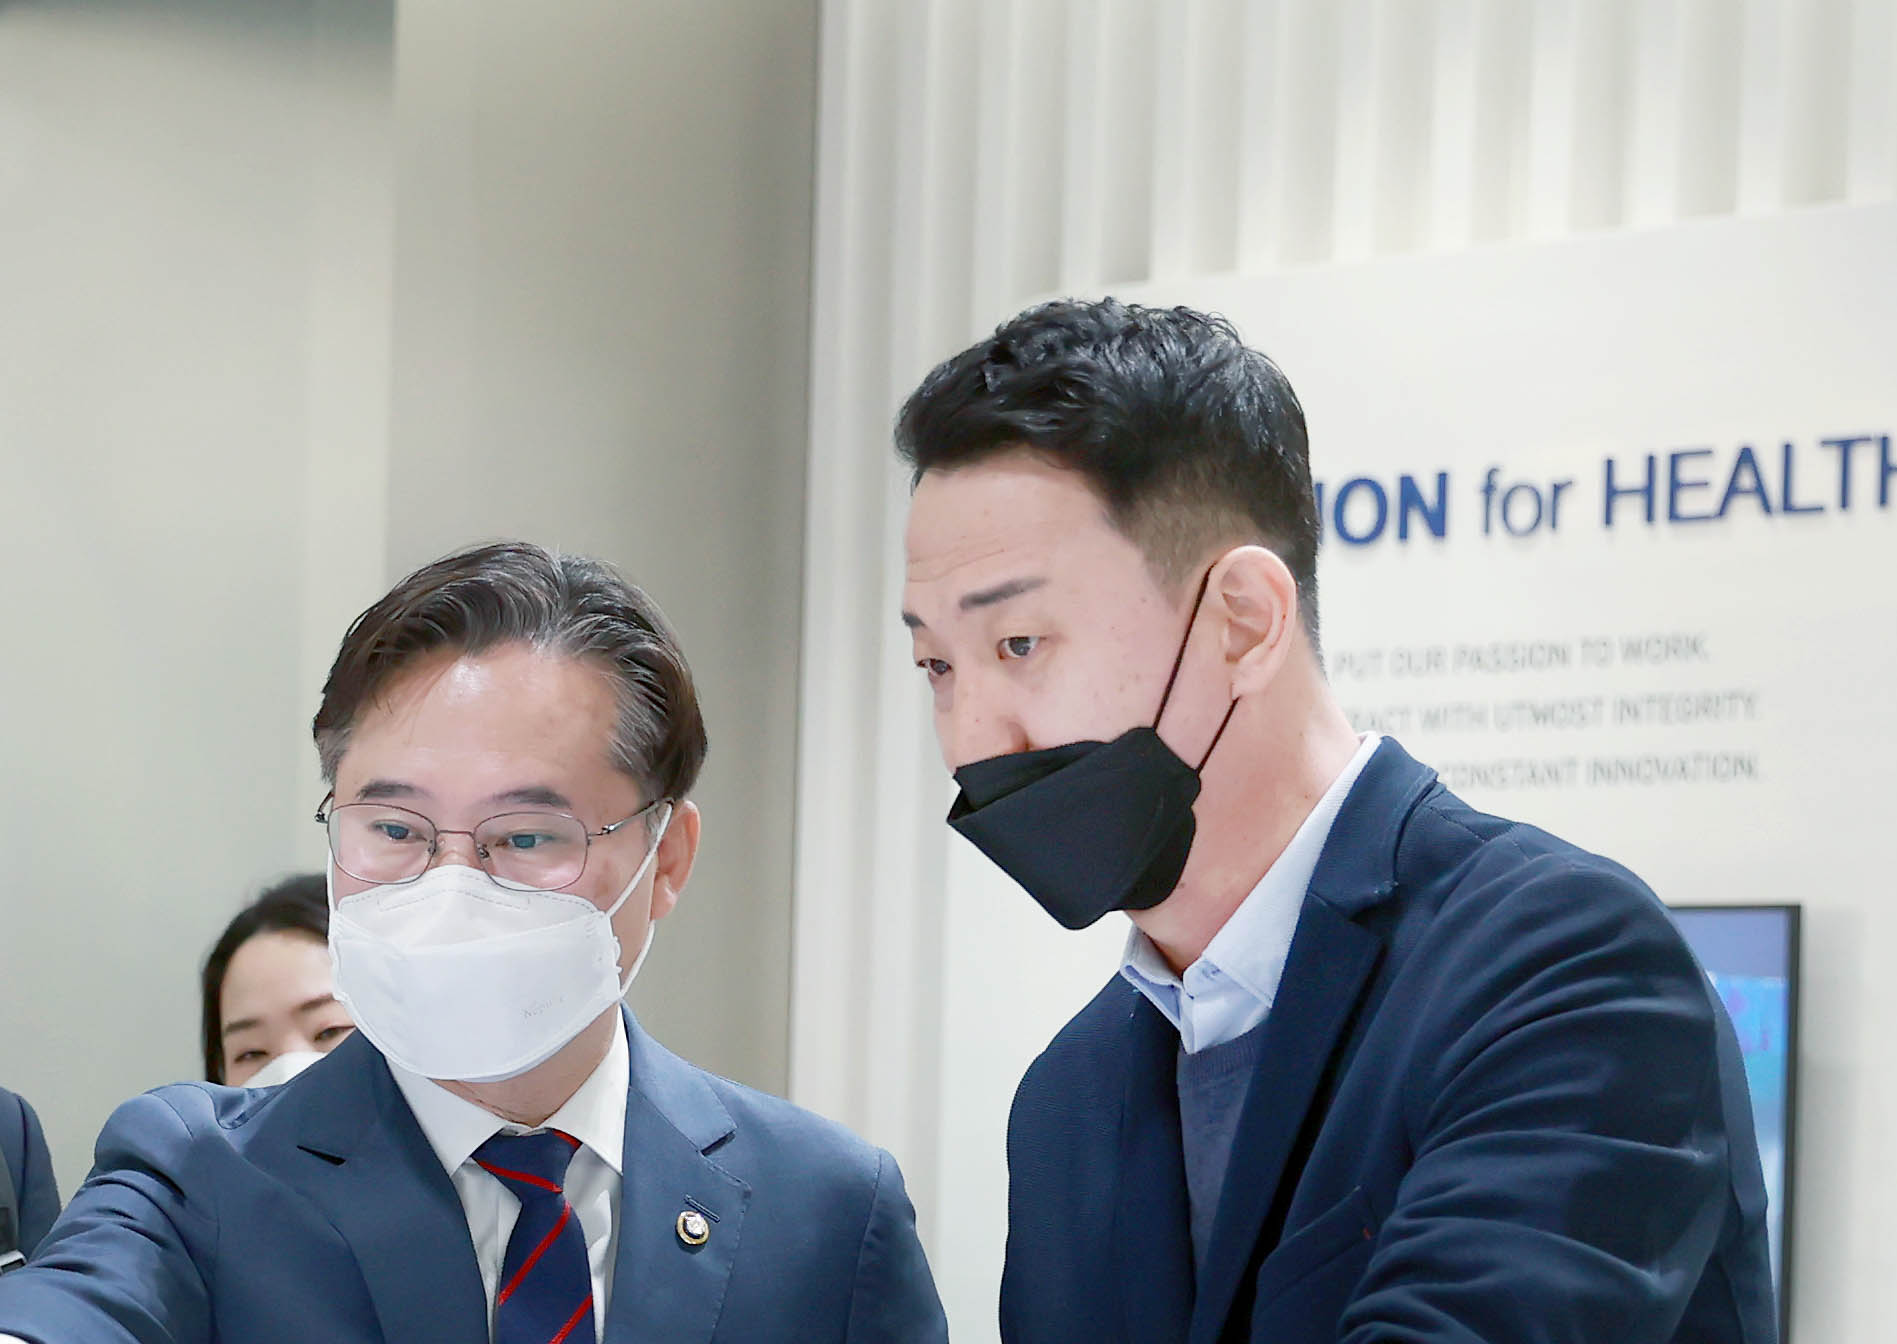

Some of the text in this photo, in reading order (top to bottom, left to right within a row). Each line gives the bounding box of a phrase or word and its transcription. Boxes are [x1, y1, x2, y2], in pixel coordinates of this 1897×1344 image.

[1481, 466, 1573, 537] for
[1333, 650, 1384, 681] PUT
[1389, 646, 1448, 679] OUR
[1454, 640, 1571, 675] PASSION
[1580, 636, 1612, 668] TO
[1419, 701, 1488, 732] WITH
[1493, 696, 1604, 731] UTMOST
